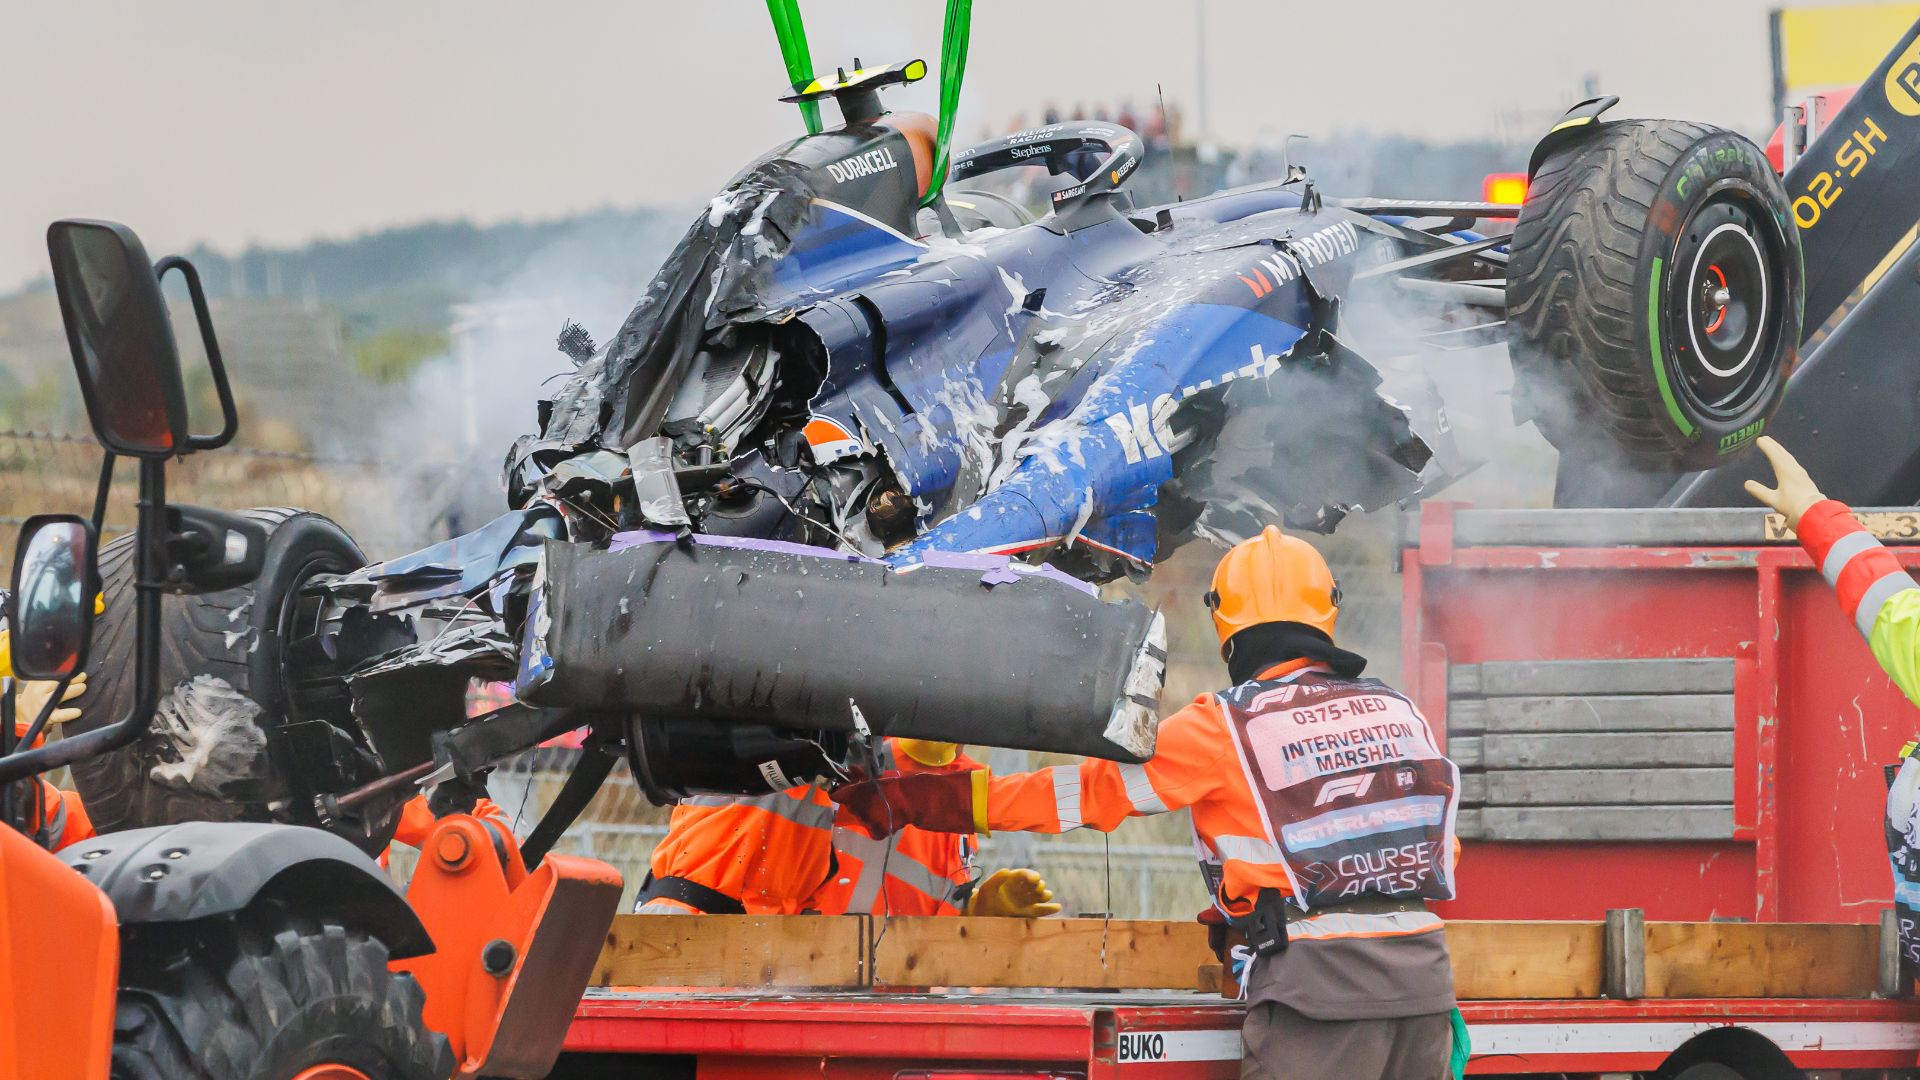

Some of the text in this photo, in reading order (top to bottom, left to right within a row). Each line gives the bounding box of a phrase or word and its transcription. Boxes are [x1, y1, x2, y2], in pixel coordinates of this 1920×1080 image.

[1010, 132, 1054, 145] RACING
[1010, 144, 1052, 159] Stephens
[826, 147, 898, 184] DURACELL
[1116, 156, 1137, 178] KEEPER
[1062, 185, 1086, 200] SARGEANT
[1292, 697, 1387, 725] 0375-NED
[1281, 723, 1414, 762] INTERVENTION
[1315, 743, 1405, 772] MARSHAL
[1338, 842, 1431, 877] COURSE
